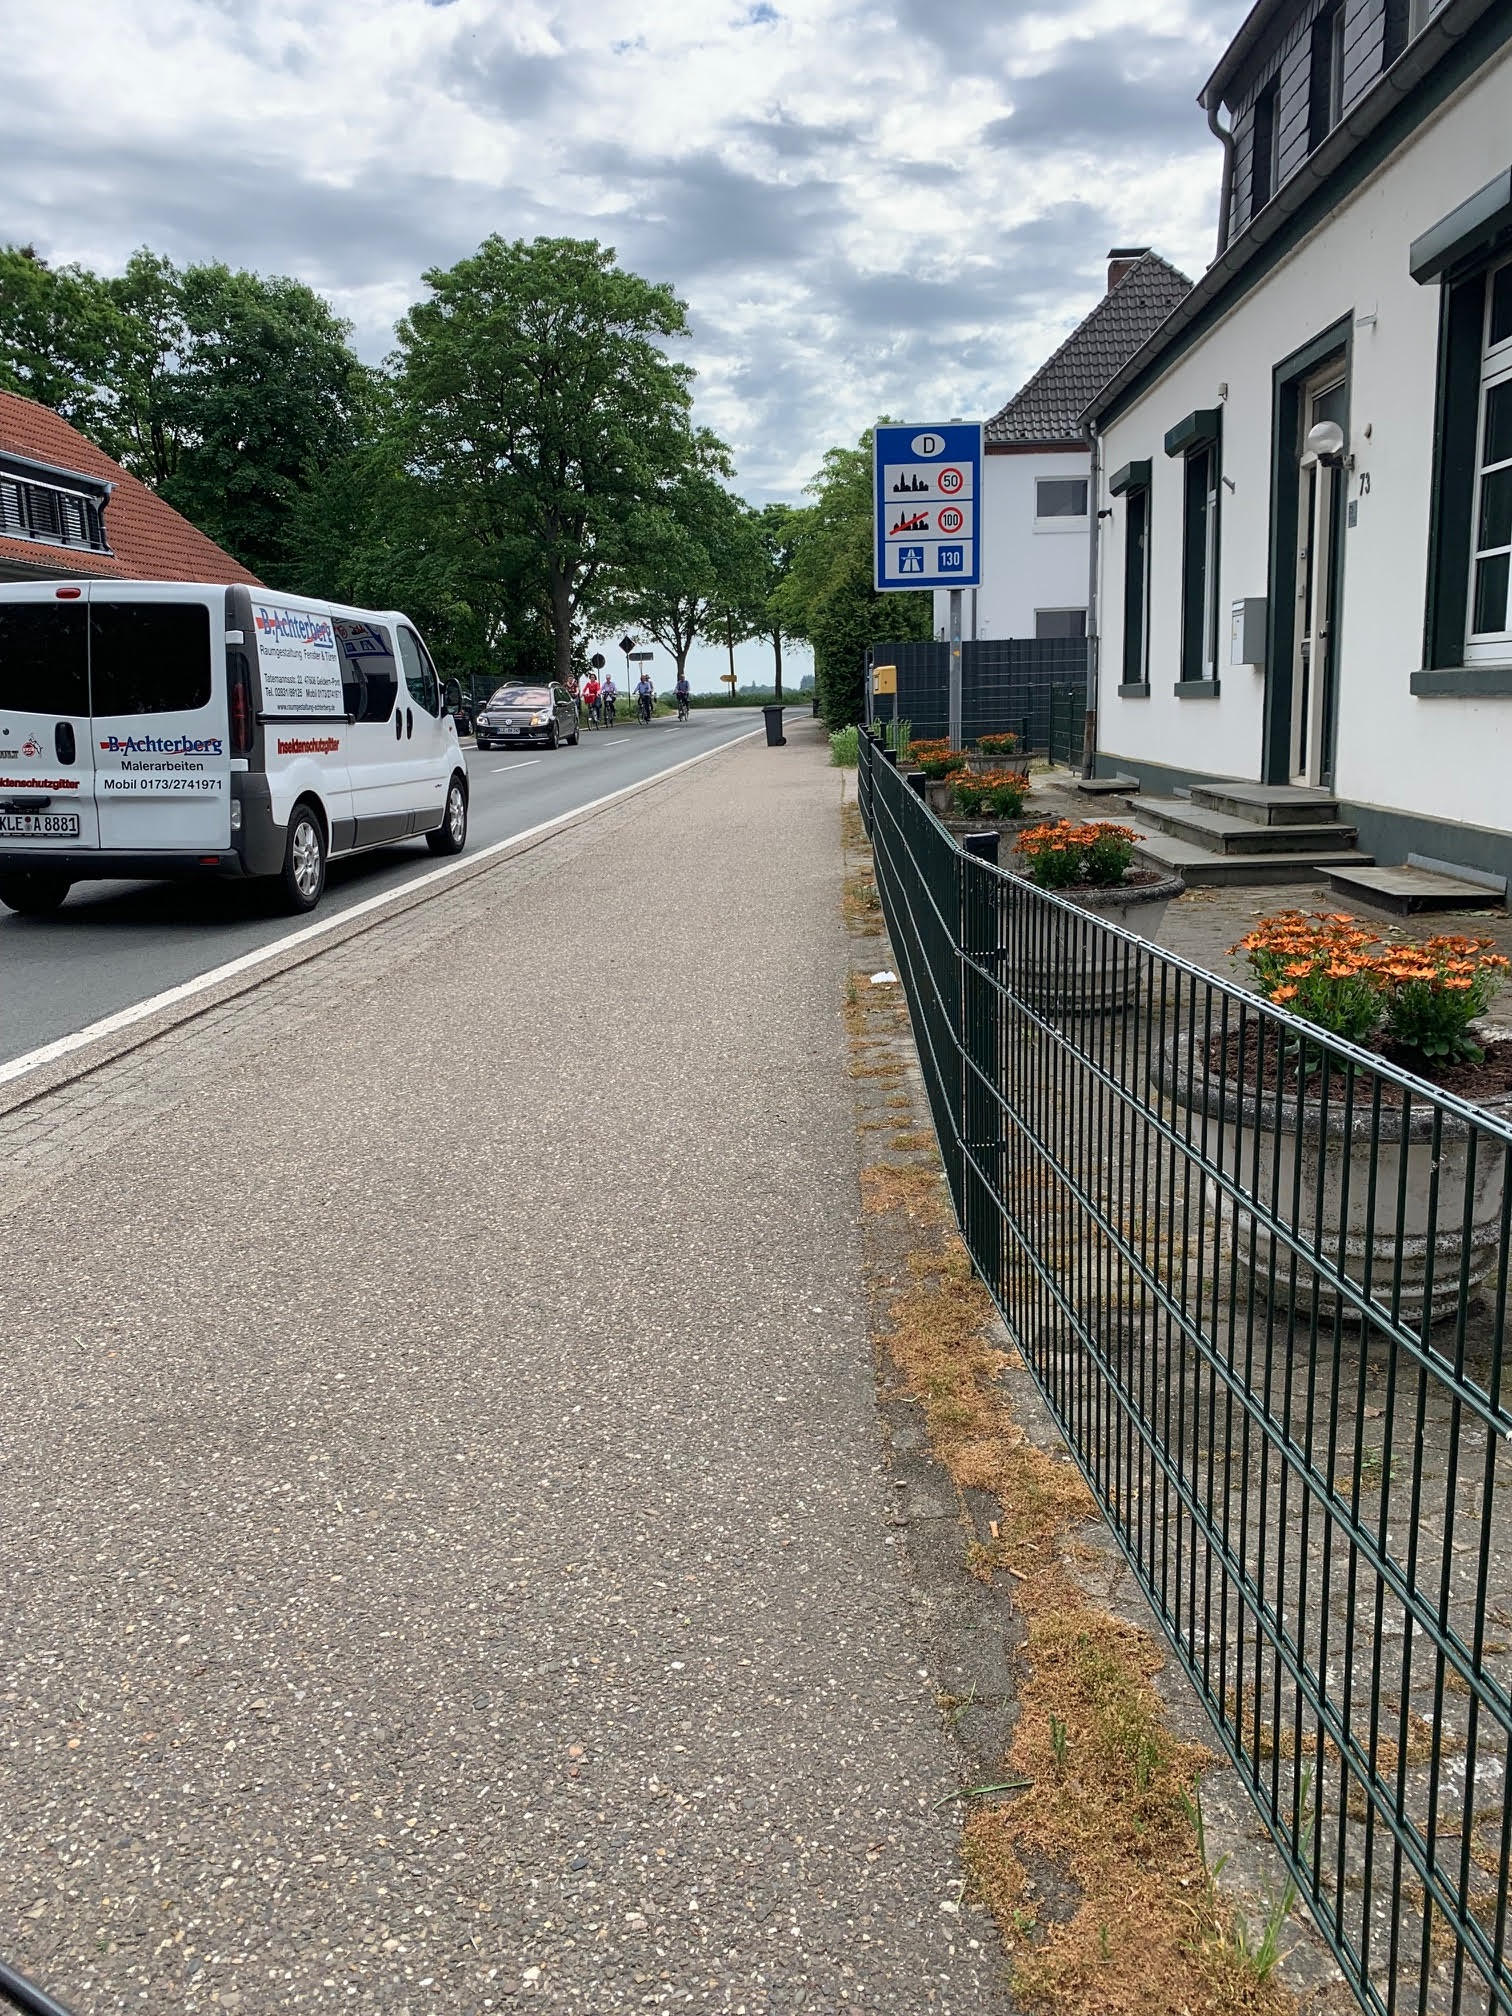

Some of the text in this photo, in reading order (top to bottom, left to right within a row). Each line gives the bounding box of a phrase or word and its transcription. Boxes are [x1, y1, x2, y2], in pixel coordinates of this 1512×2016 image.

[923, 436, 936, 454] D
[943, 474, 959, 488] 50
[1359, 471, 1370, 497] 73
[942, 513, 959, 527] 100
[941, 551, 960, 566] 130
[260, 644, 302, 661] Raumgestaltung
[304, 649, 320, 659] Fenster
[265, 687, 274, 697] Tel.
[306, 688, 317, 698] Mobil
[108, 735, 223, 757] B.Achterberg
[121, 760, 204, 771] Malerarbeiten
[104, 779, 222, 790] Mobil 0173/2741971
[34, 816, 41, 832] A
[44, 816, 76, 832] 8881
